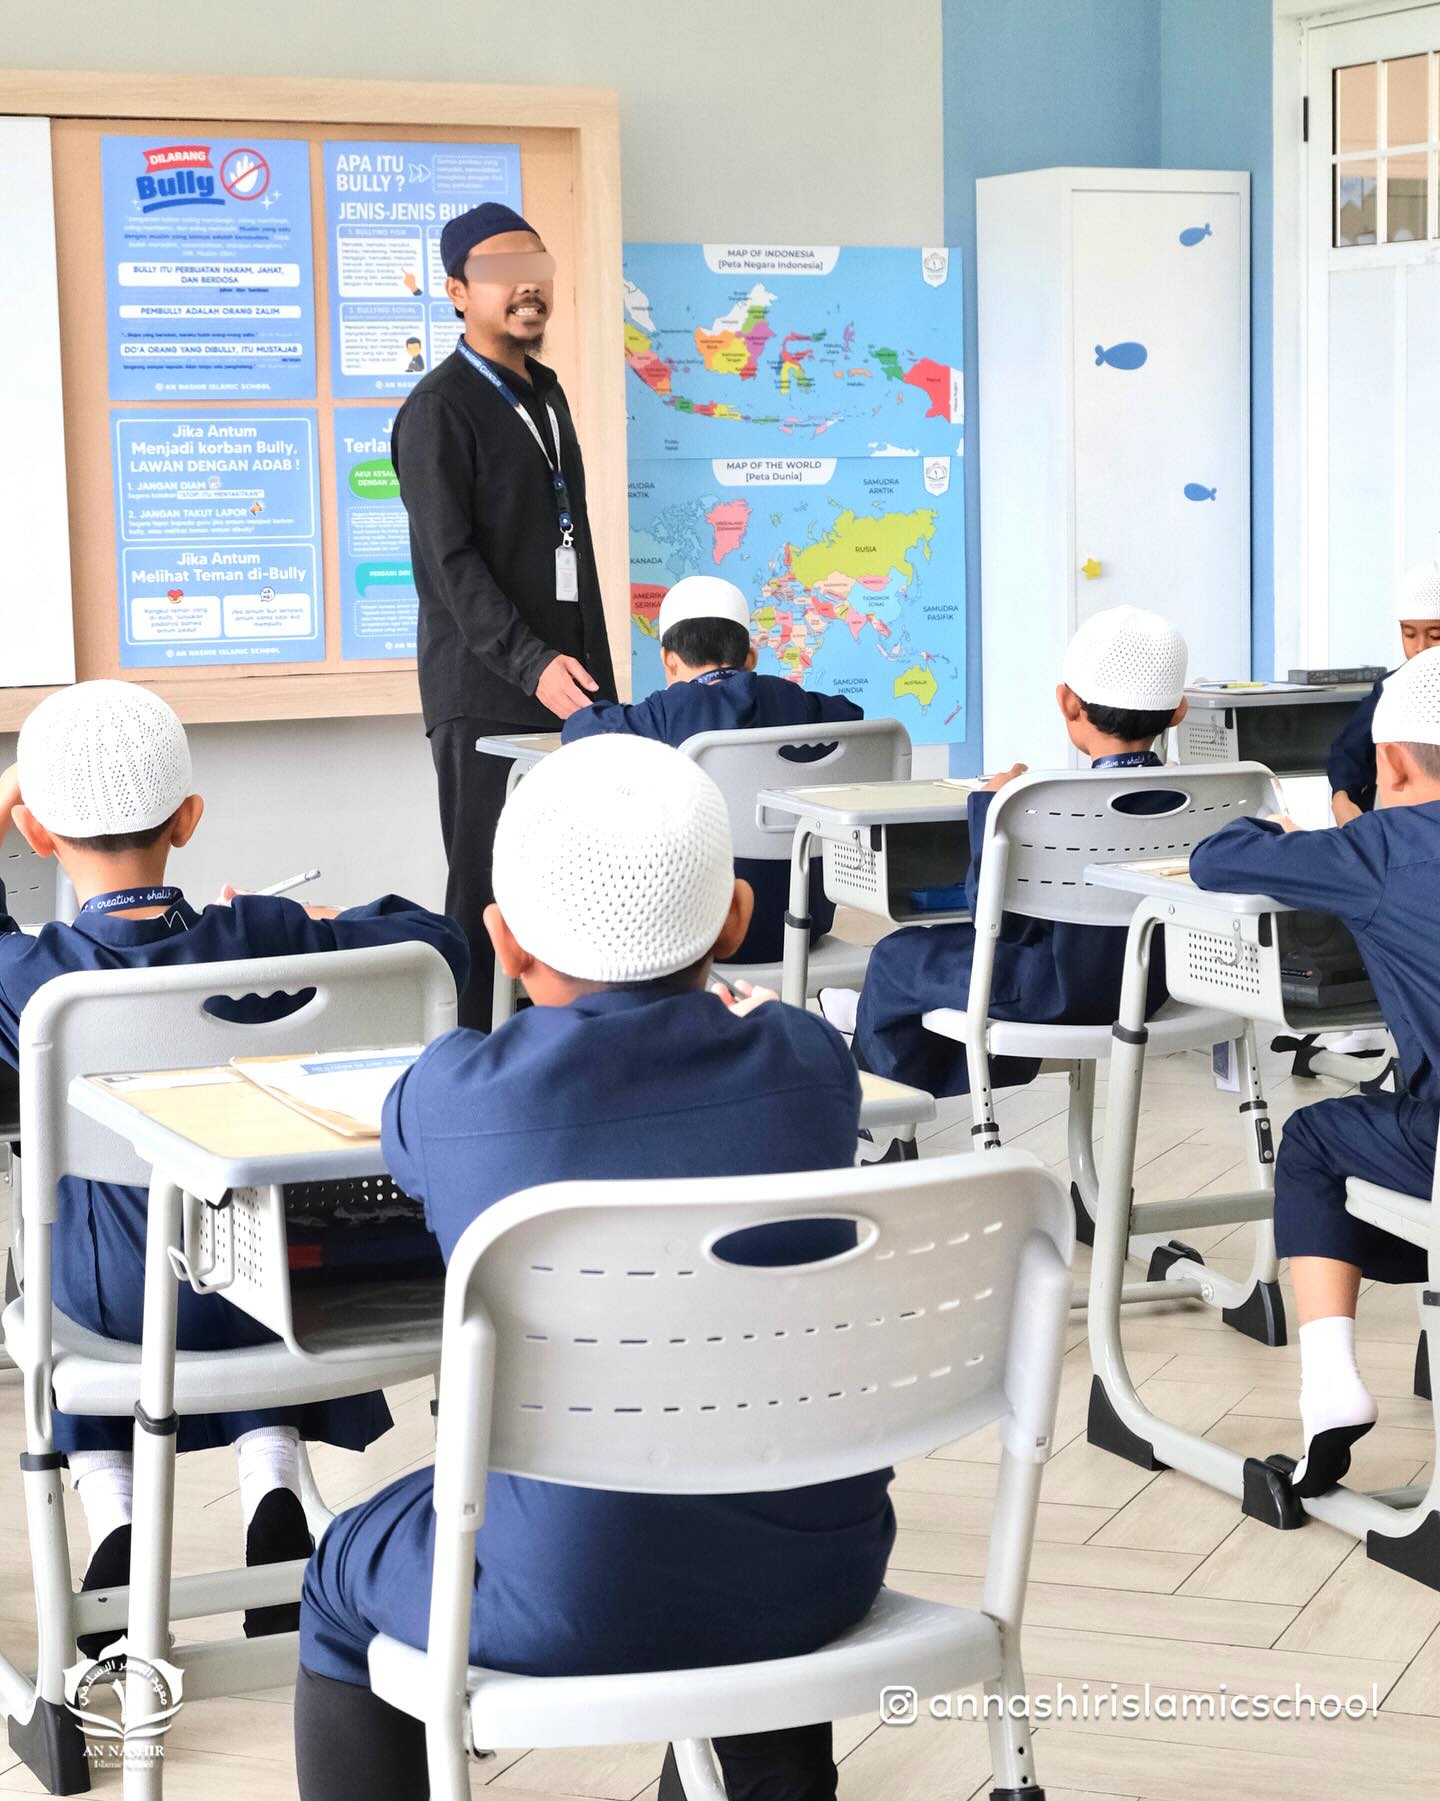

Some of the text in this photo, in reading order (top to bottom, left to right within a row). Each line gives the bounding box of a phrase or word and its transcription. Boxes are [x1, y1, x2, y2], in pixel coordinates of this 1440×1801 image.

[150, 150, 206, 165] DILARANG
[336, 154, 404, 172] APA ITU
[136, 170, 215, 200] Bully
[336, 174, 406, 192] BULLY ?
[339, 202, 436, 221] JENIS-JENIS
[728, 249, 815, 258] MAP OF INDONESIA
[133, 265, 285, 275] BULLY ITU PERBUATAN HARAM, JAHAT,
[718, 260, 823, 270] [Peta Negara Indonesia]
[181, 275, 239, 284] DAN BERDOSA
[140, 307, 280, 316] PEMBULLY ADALAH ORANG ZALIM
[147, 346, 178, 354] ORANG
[180, 346, 202, 354] YANG
[204, 346, 239, 355] DIBULLY,
[172, 424, 257, 438] Jika Antum
[131, 442, 194, 457] Menjadi
[198, 441, 252, 454] korban
[130, 460, 183, 472] LAWAN
[187, 460, 248, 472] DENGAN
[252, 459, 292, 471] ADAB
[726, 461, 822, 470] MAP OF THE WORLD
[746, 472, 802, 482] [Peta Dunia]
[137, 482, 178, 490] JANGAN
[180, 481, 206, 490] DIAM
[863, 478, 899, 487] SAMUDRA
[869, 486, 894, 495] ARKTIK
[139, 510, 181, 519] JANGAN
[183, 509, 213, 518] TAKUT
[215, 508, 247, 518] LAPOR
[176, 552, 260, 566] Jika Antum
[630, 557, 663, 565] KANADA
[131, 567, 307, 583] Melihat Teman di-Bully
[923, 604, 959, 613] SAMUDRA
[927, 613, 955, 621] PASIFIK
[832, 678, 869, 687] SAMUDRA
[837, 686, 864, 695] HINDIA
[97, 895, 136, 910] creative
